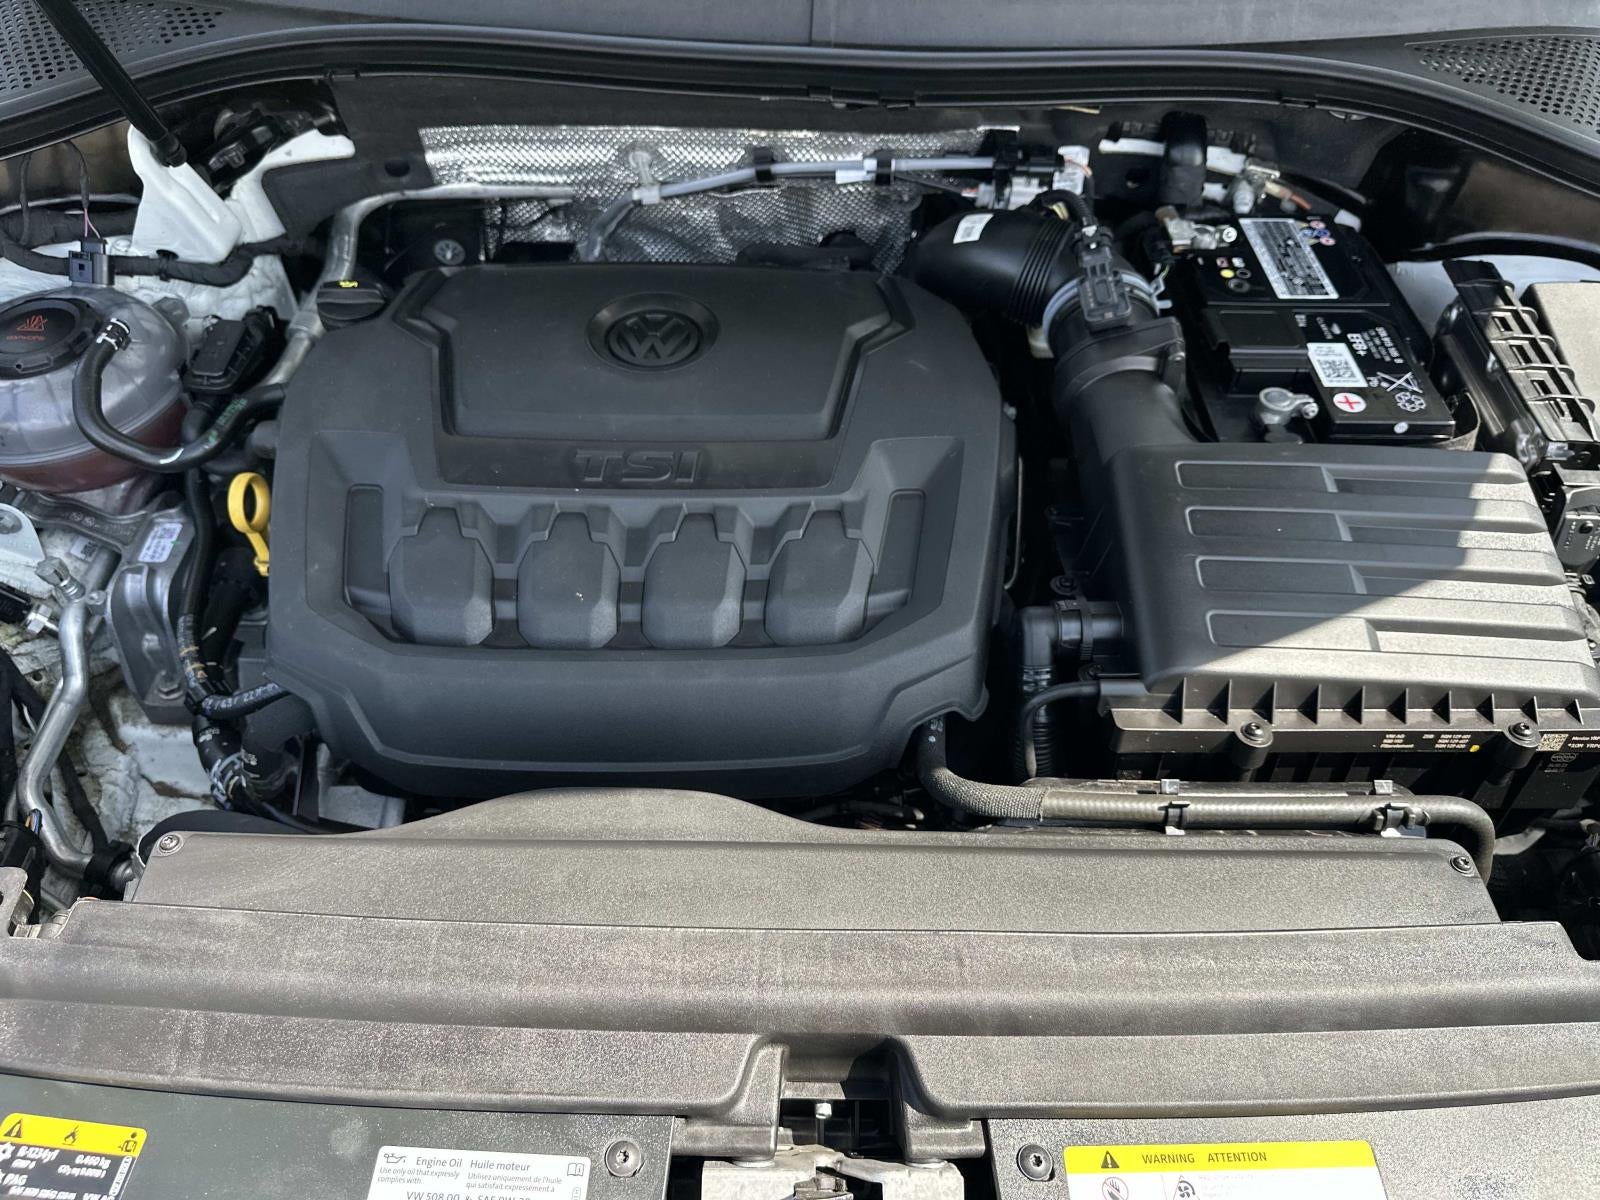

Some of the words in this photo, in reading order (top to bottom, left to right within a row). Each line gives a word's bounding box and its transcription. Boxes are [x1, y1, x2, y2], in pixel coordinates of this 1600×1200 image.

[1347, 333, 1368, 357] EFB+
[574, 449, 701, 484] TSI
[16, 1145, 60, 1163] R-1234yf
[1142, 1153, 1195, 1164] WARNING
[1207, 1151, 1267, 1163] ATTENTION
[416, 1156, 447, 1169] Engine
[449, 1158, 463, 1168] Oil
[470, 1159, 494, 1170] Huile
[496, 1161, 531, 1172] moteur
[2, 1172, 28, 1186] PAG
[377, 1176, 406, 1184] complies
[392, 1167, 406, 1176] only
[416, 1168, 430, 1176] that
[431, 1170, 460, 1180] expressly
[467, 1172, 492, 1181] Utilisez
[492, 1174, 532, 1183] uniquement
[465, 1182, 477, 1190] qui
[478, 1182, 503, 1190] satisfait
[406, 1191, 425, 1200] VW
